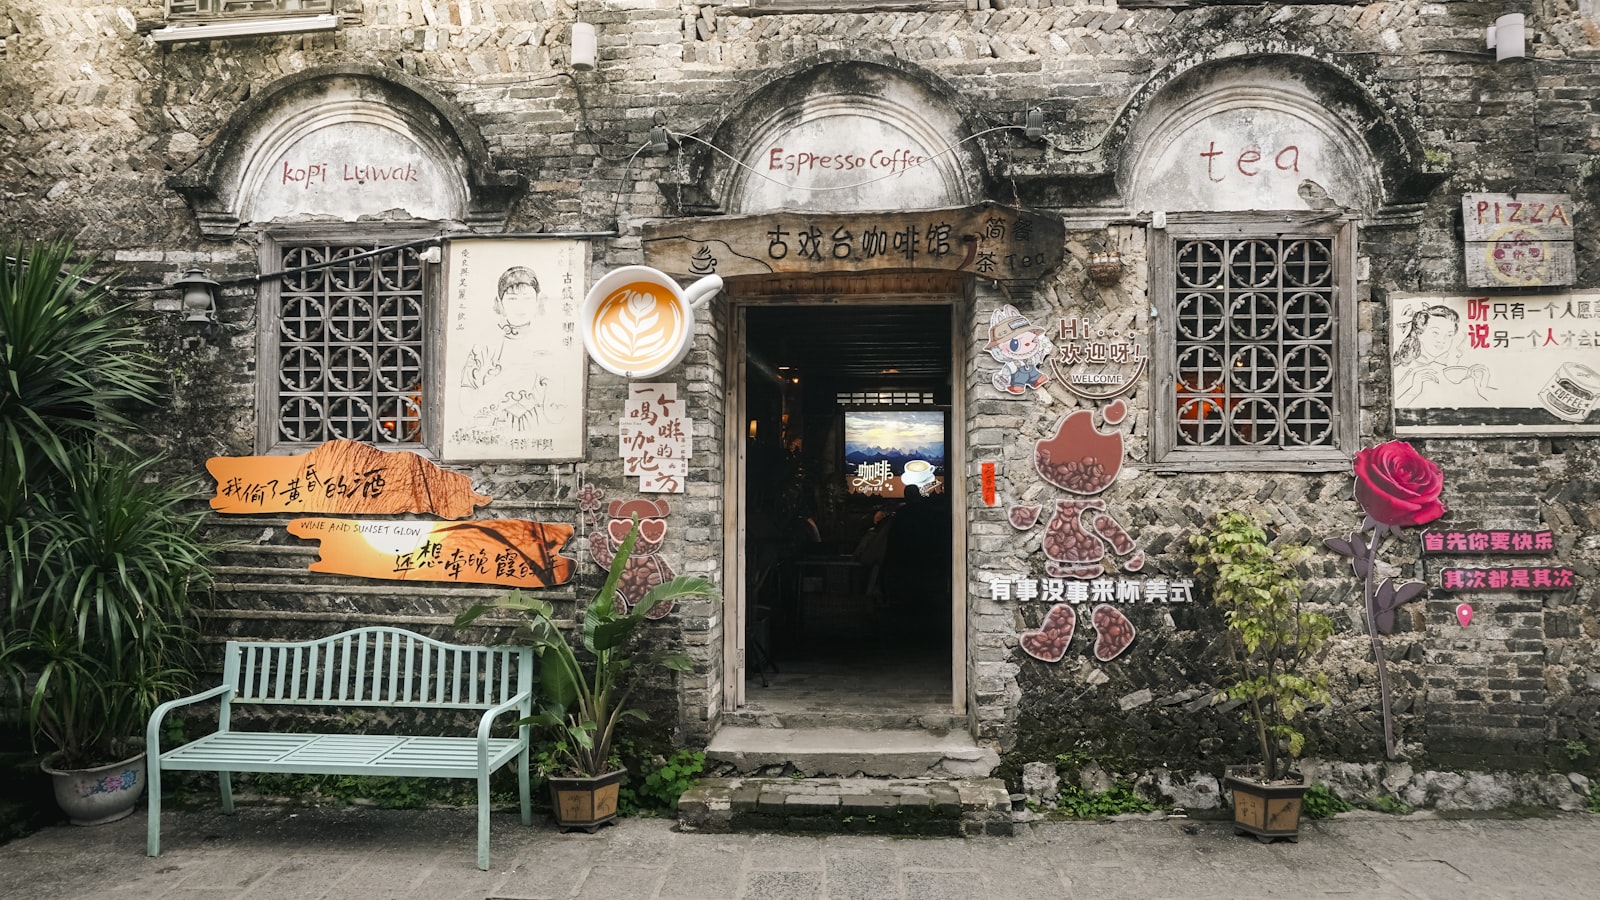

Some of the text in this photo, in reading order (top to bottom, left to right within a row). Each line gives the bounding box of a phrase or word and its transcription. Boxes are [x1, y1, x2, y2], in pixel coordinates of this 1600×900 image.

[343, 163, 418, 183] Luwak
[769, 148, 927, 178] Espresso Coffee
[1200, 141, 1299, 183] tea
[1477, 201, 1568, 226] PIZZA
[766, 222, 953, 261] 古戏台咖啡馆
[984, 216, 1034, 242] 简餐
[975, 251, 1046, 274] 茶 Tea
[1072, 374, 1122, 384] WELCOME
[1554, 388, 1583, 408] COFFEE
[221, 463, 388, 506] 我偷了黄昏的酒
[852, 460, 894, 487] 咖啡
[300, 521, 421, 536] WINE AND SUNSET GLOW
[1424, 532, 1553, 551] 首先你要快乐
[989, 577, 1195, 604] 有事没事来杯美式
[1444, 568, 1574, 589] 其次都是其次
